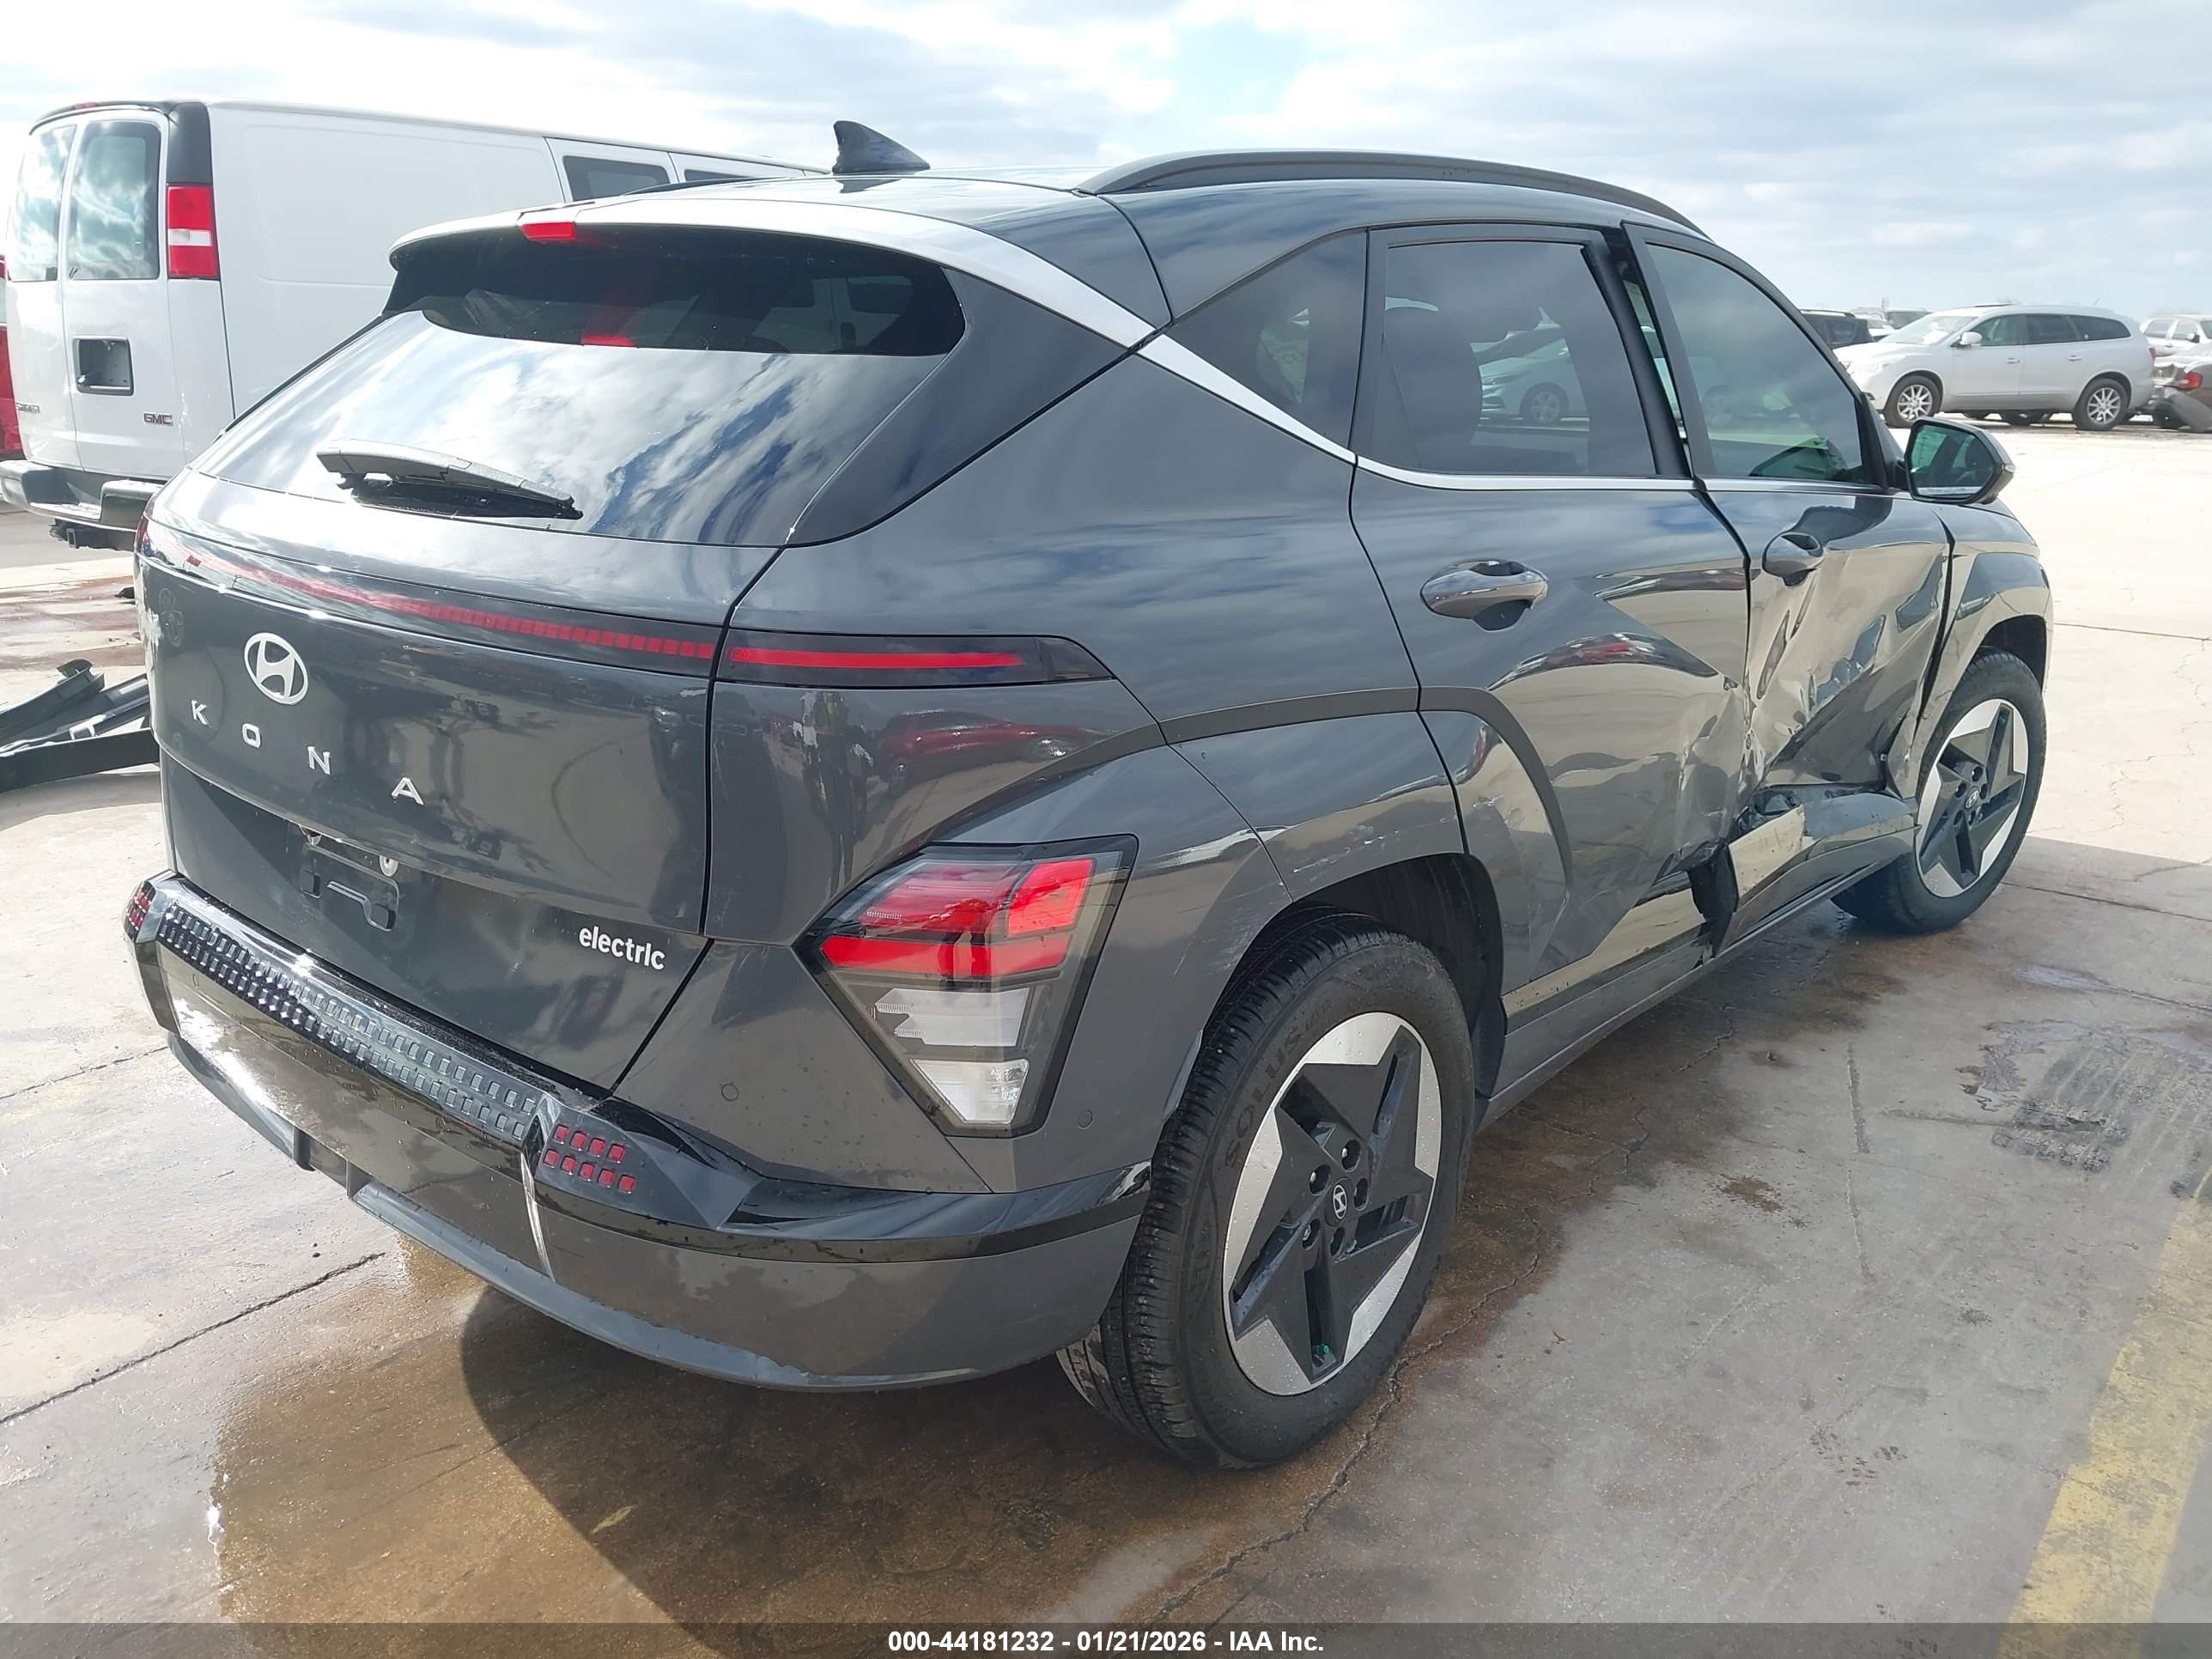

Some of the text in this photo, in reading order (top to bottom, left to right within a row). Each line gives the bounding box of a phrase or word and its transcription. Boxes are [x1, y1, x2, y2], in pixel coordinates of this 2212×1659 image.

[143, 412, 173, 427] GMC
[191, 700, 424, 805] KONA
[579, 926, 665, 970] electric
